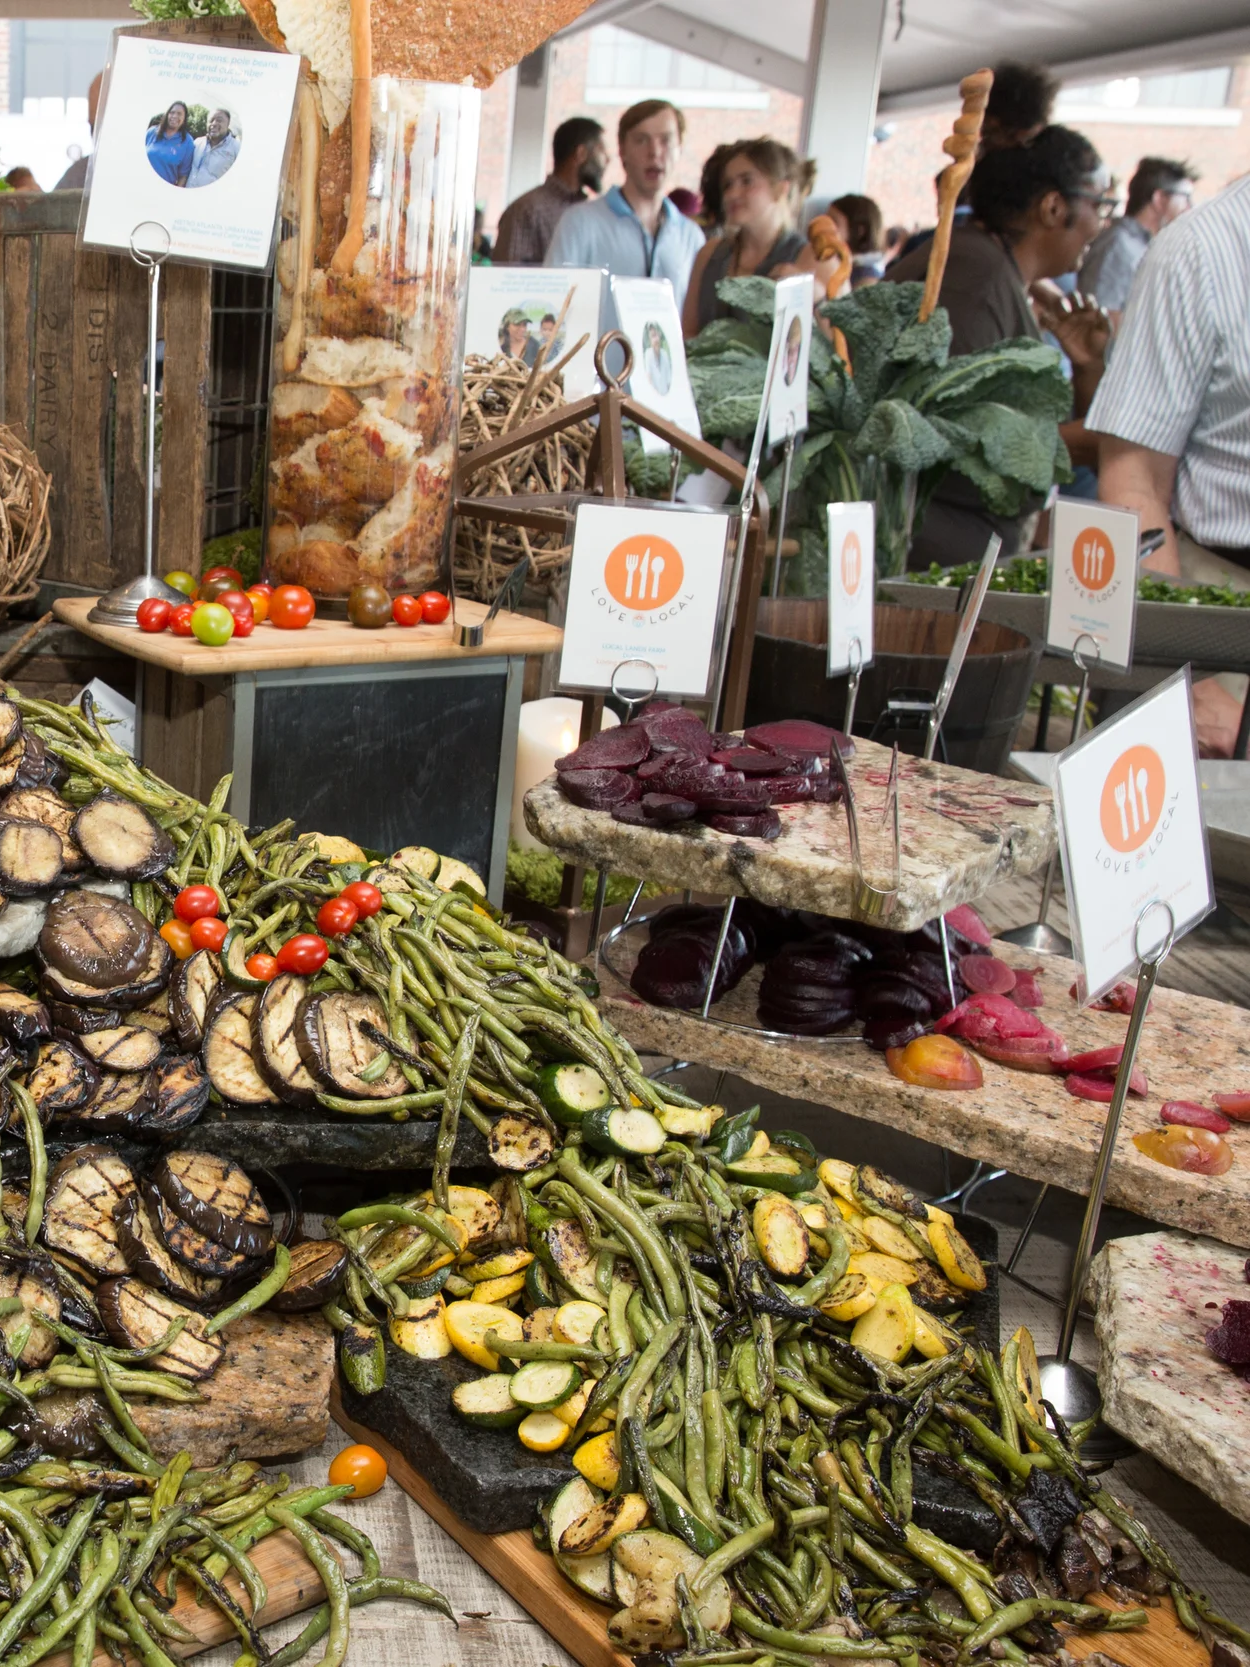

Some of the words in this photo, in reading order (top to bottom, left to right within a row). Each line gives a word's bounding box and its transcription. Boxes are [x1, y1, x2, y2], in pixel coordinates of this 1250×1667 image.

[168, 50, 195, 62] spring
[230, 55, 250, 67] pole
[178, 60, 199, 71] basil
[200, 62, 217, 73] and
[158, 70, 172, 78] are
[174, 70, 192, 81] ripe
[192, 71, 206, 81] for
[206, 74, 228, 85] your
[41, 312, 58, 330] 2
[40, 353, 58, 450] DAIRY
[591, 588, 626, 621] LOVE
[650, 594, 694, 624] LOCAL
[1095, 848, 1130, 873] LOVE
[1149, 792, 1179, 856] LOCAL
